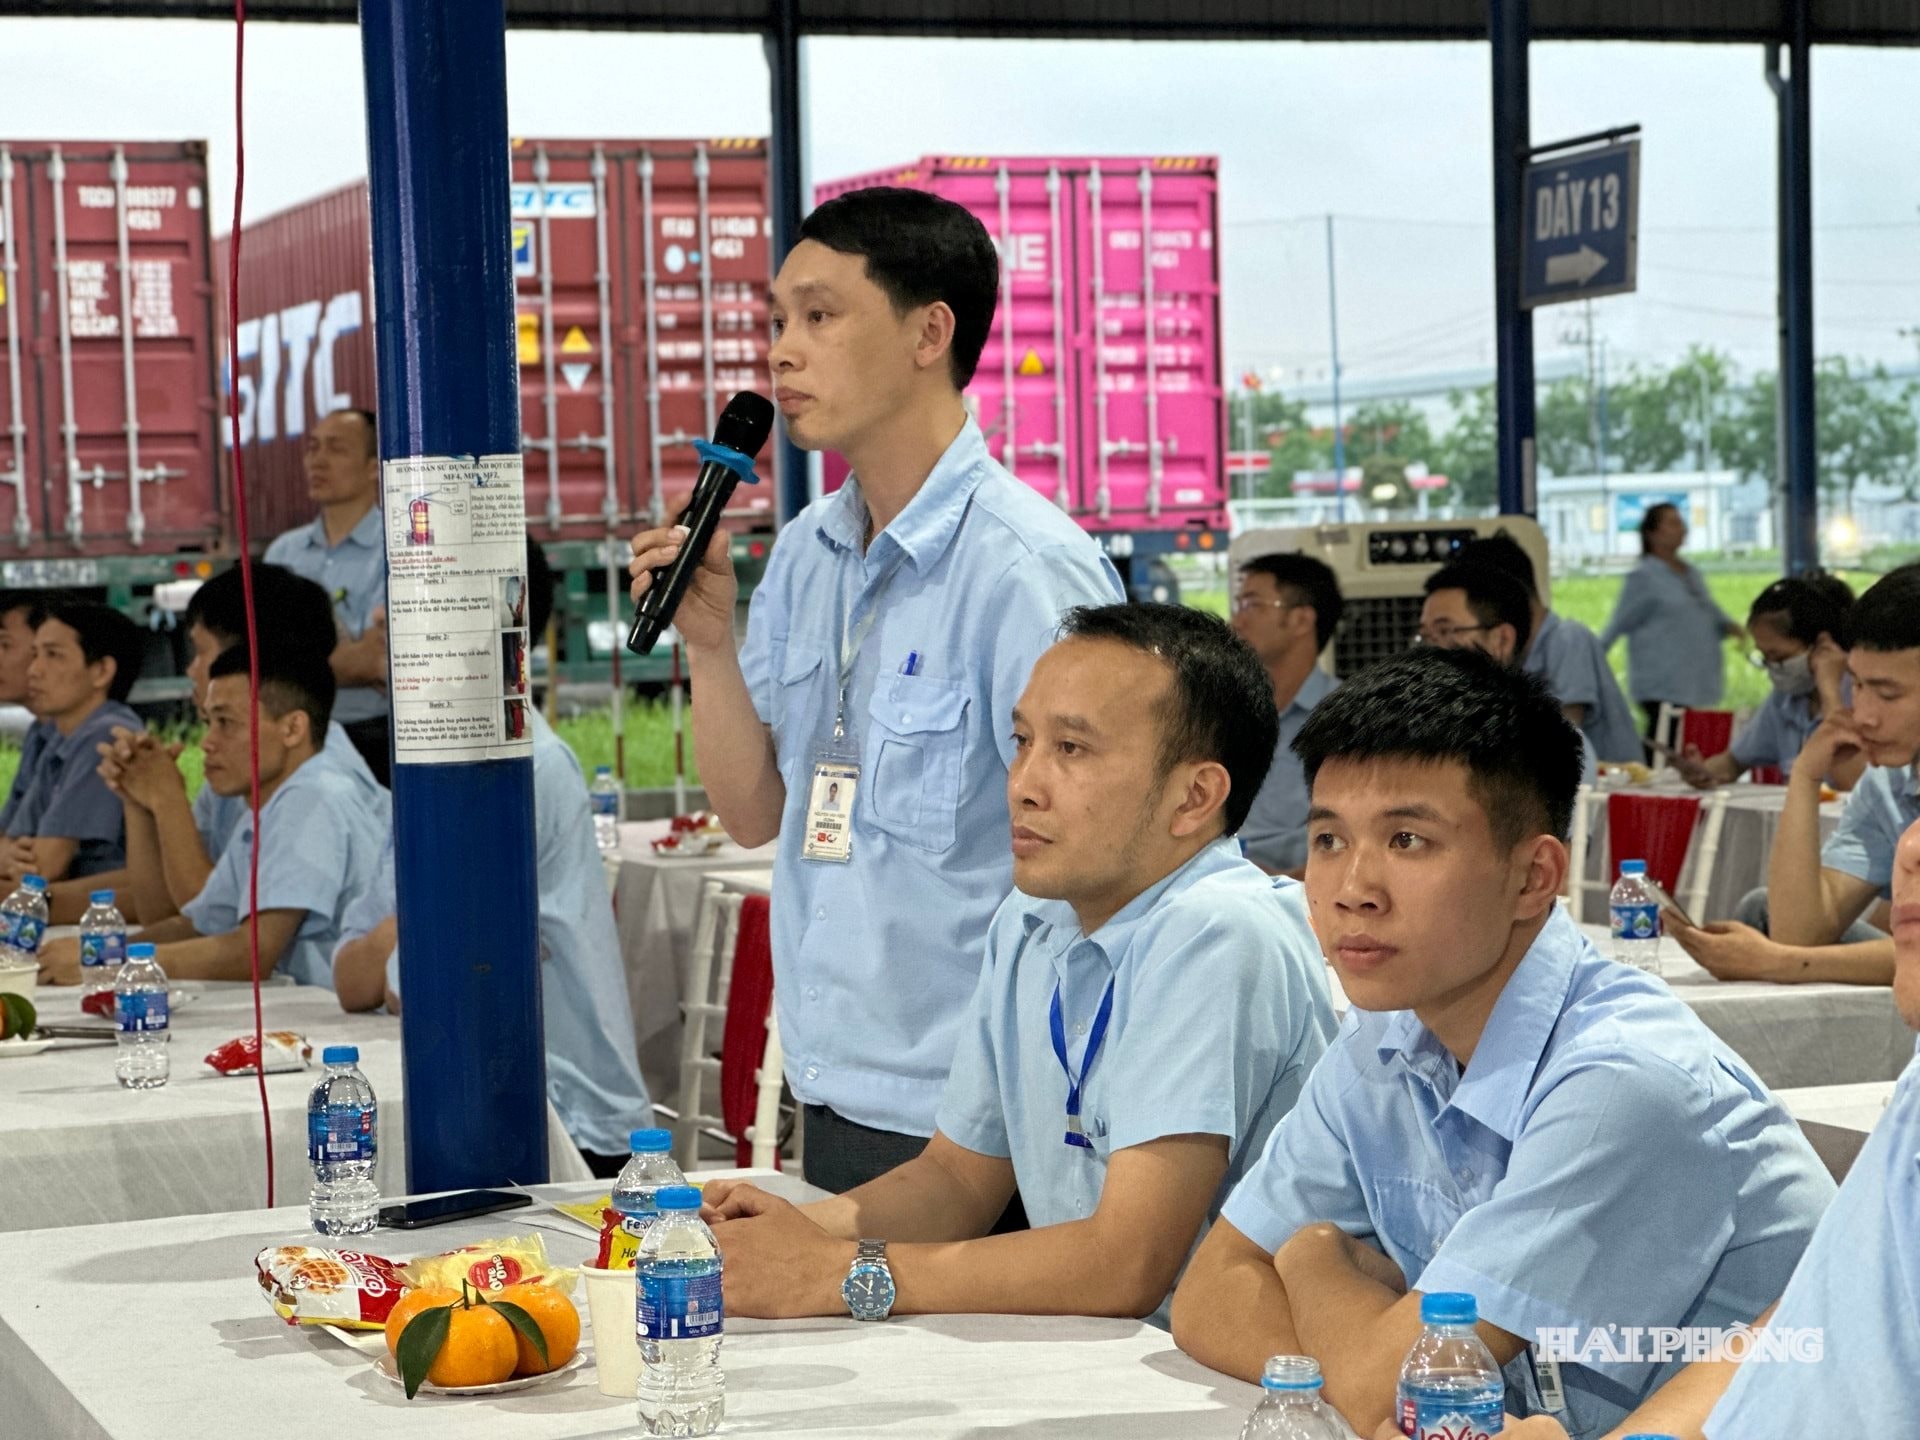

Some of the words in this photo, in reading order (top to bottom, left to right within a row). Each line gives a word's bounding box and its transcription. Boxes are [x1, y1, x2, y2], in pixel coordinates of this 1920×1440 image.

[1589, 173, 1620, 232] 13
[224, 291, 363, 448] SITC
[487, 1266, 504, 1291] One
[492, 1254, 508, 1280] One
